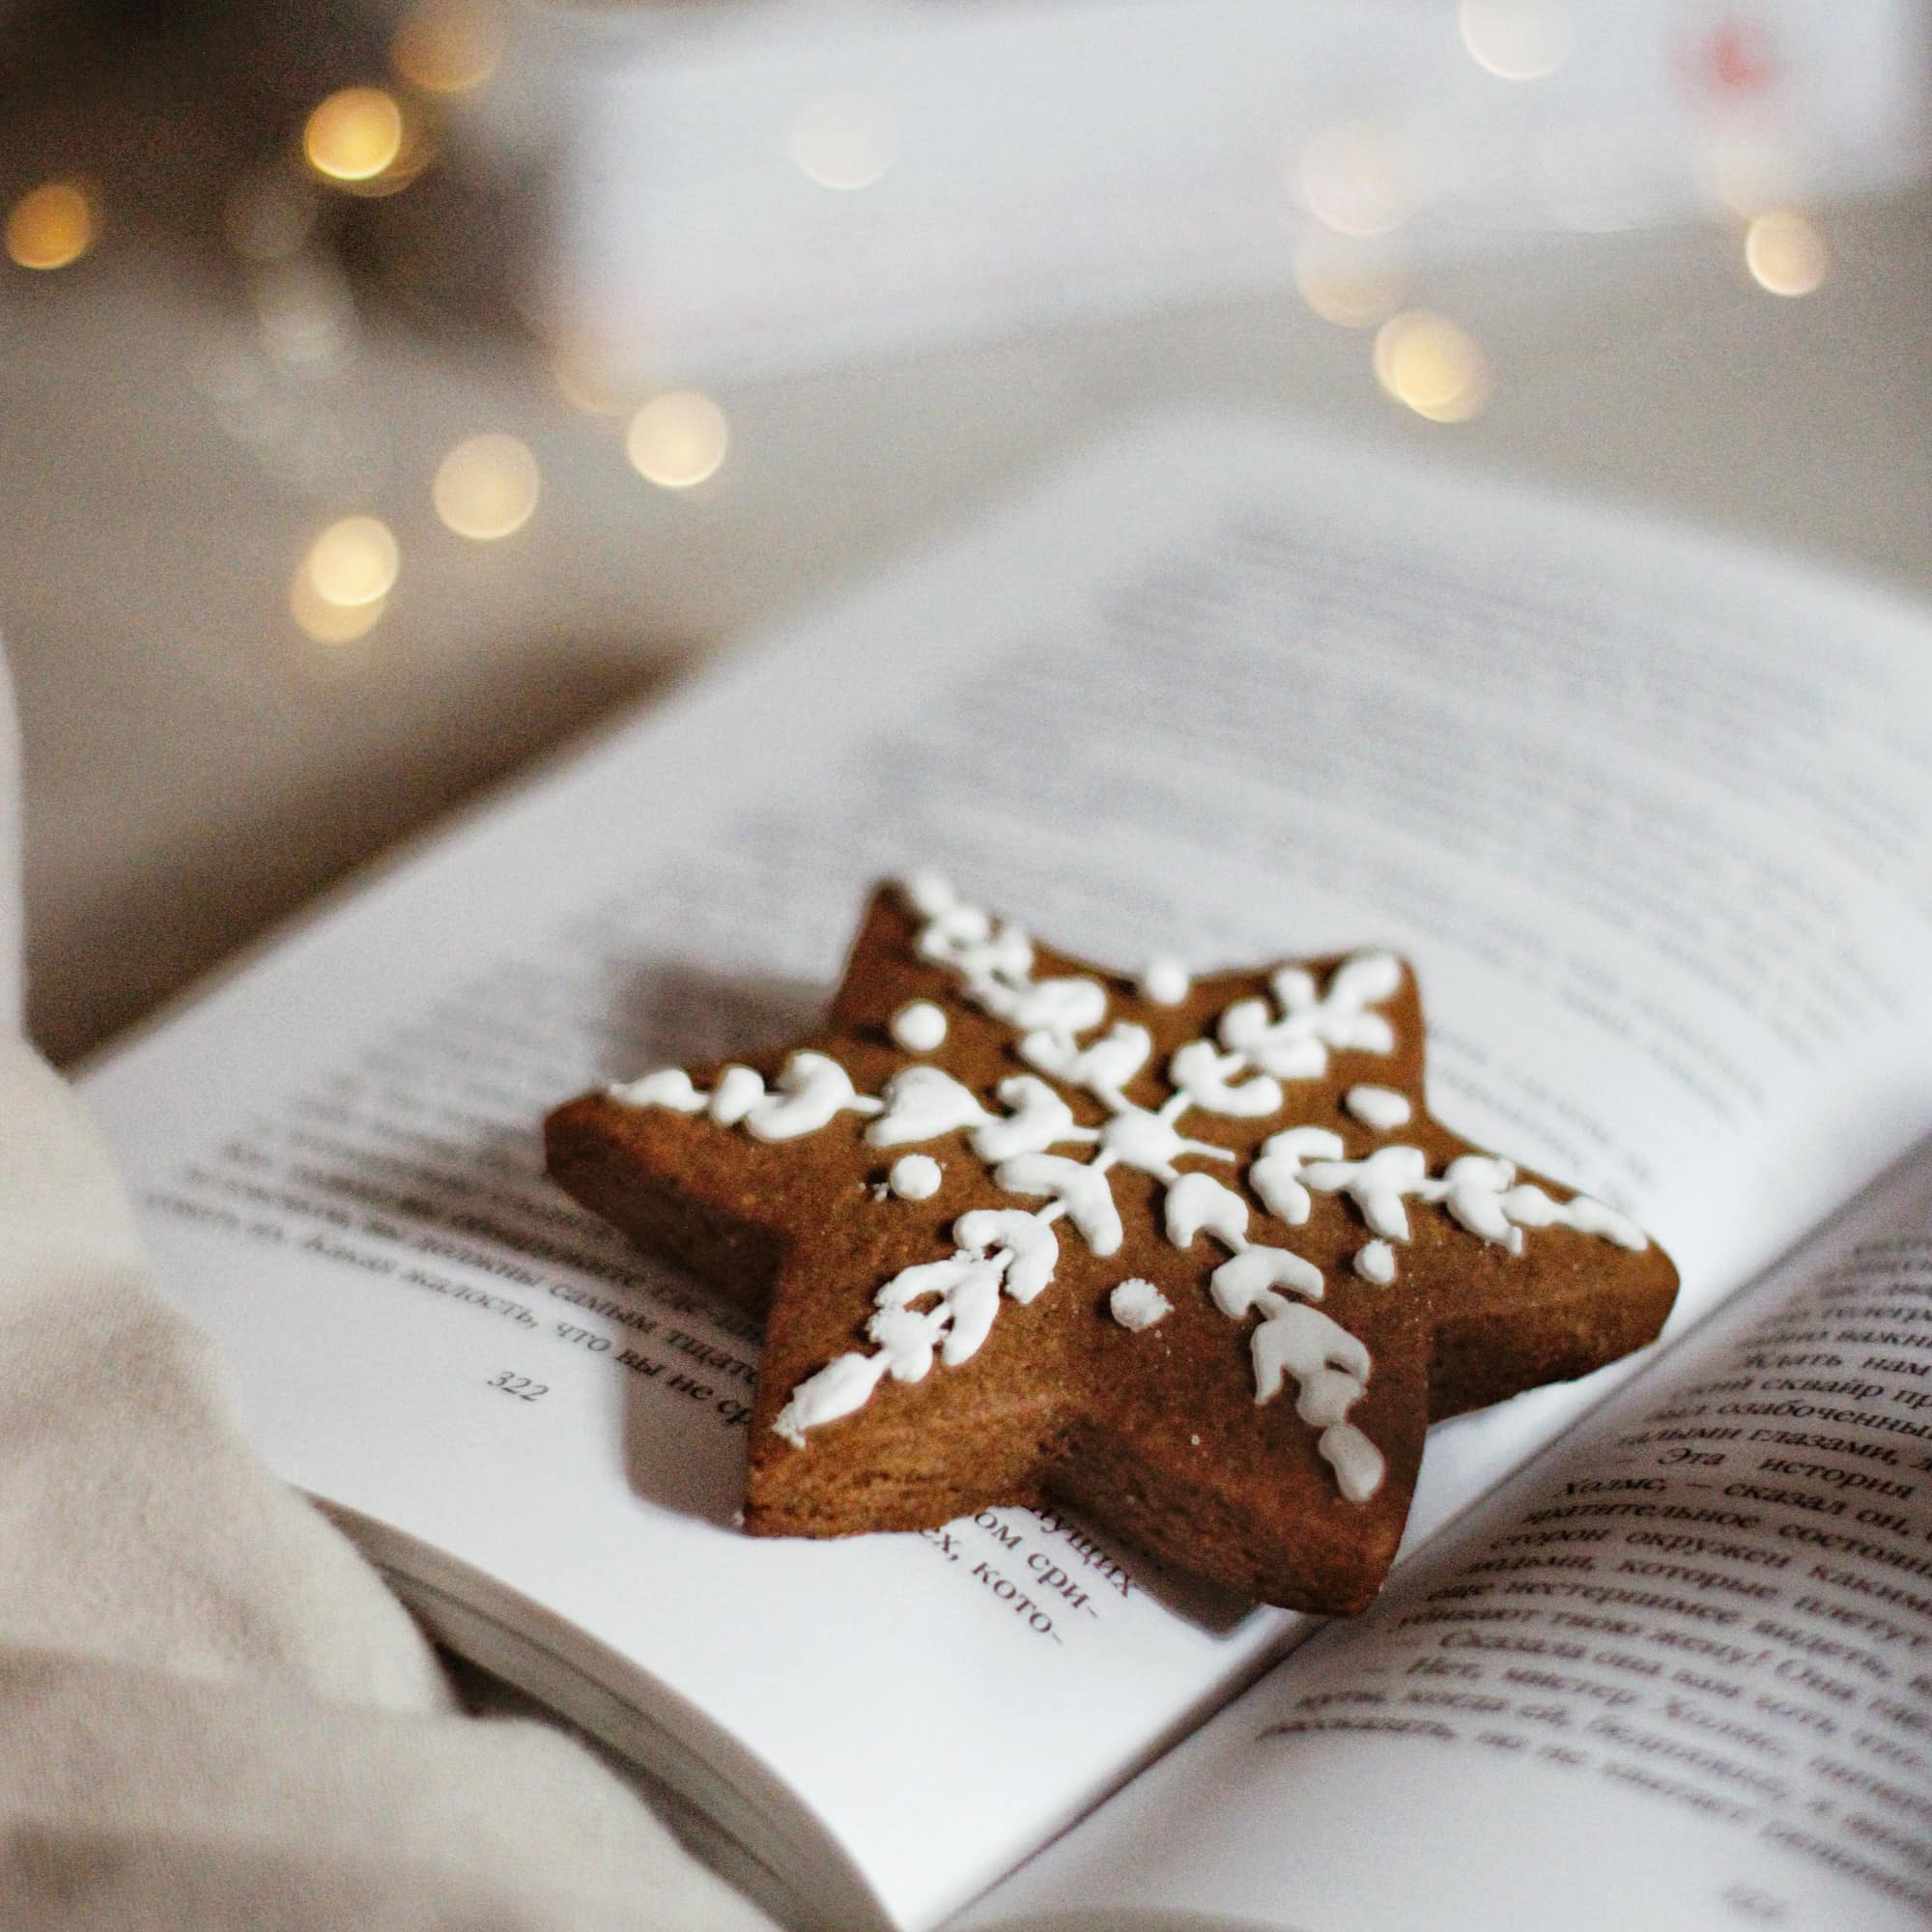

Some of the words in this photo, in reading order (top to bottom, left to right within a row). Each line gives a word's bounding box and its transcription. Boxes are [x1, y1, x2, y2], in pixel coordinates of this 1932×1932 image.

[487, 1370, 550, 1403] 322
[555, 1321, 612, 1352] что
[615, 1349, 666, 1377] вы
[667, 1374, 715, 1402] не
[1760, 1378, 1885, 1402] сквайр
[1717, 1400, 1932, 1440] озабоченны
[1747, 1429, 1898, 1465] глазами,
[1657, 1447, 1726, 1466] Эта
[1756, 1457, 1917, 1500] история
[1723, 1482, 1848, 1516] сказал
[1855, 1508, 1911, 1537] он,
[1031, 1503, 1129, 1597] ущих
[1777, 1523, 1932, 1578] состоян
[972, 1561, 1063, 1645] кото-
[1027, 1552, 1098, 1618] сри-
[1613, 1559, 1779, 1600] которые
[1808, 1564, 1932, 1620] каким
